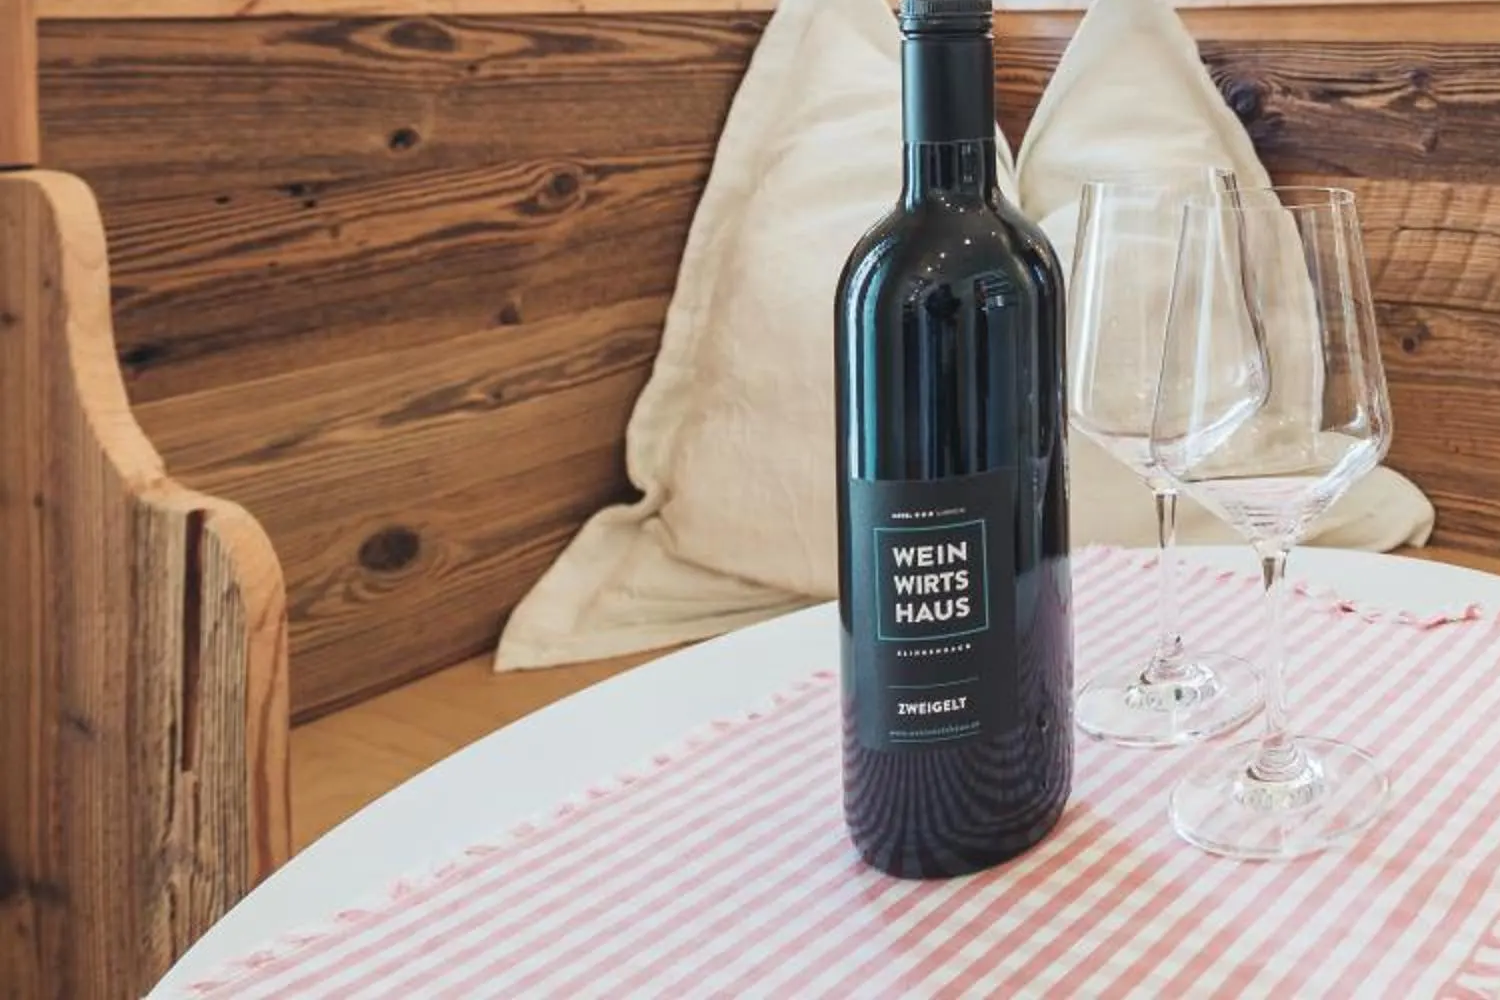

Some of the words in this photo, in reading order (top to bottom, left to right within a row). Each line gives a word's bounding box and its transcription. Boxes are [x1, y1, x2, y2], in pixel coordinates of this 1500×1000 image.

[891, 540, 968, 568] WEIN
[893, 570, 969, 596] WIRTS
[895, 597, 971, 624] HAUS
[897, 696, 967, 715] ZWEIGELT
